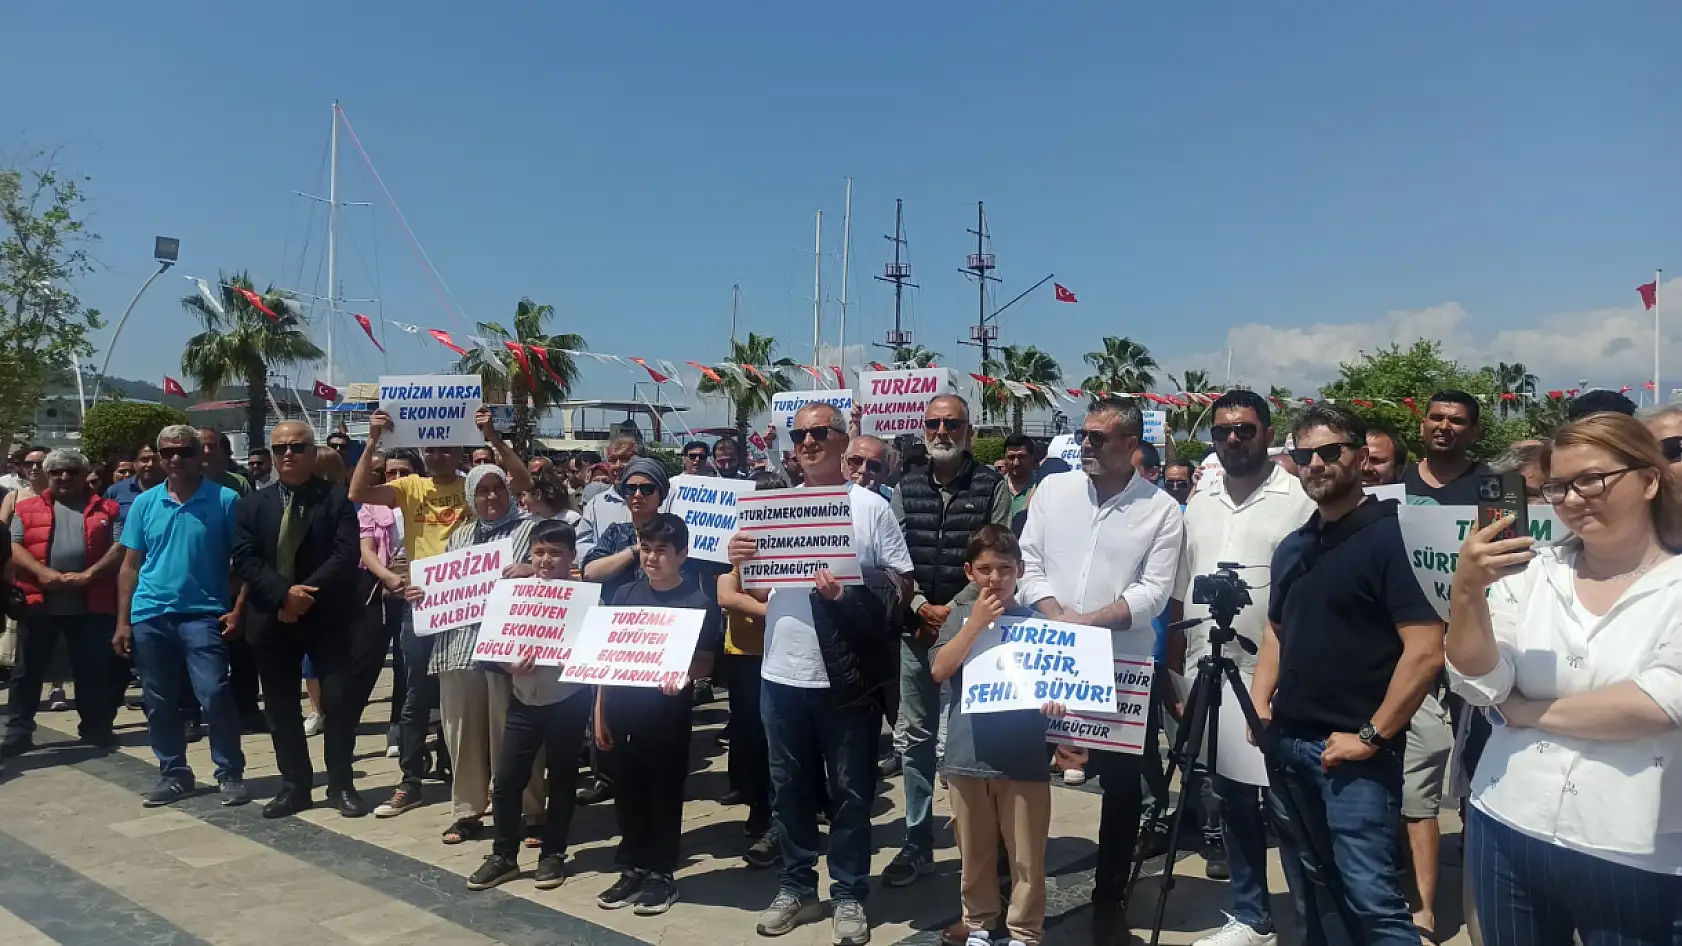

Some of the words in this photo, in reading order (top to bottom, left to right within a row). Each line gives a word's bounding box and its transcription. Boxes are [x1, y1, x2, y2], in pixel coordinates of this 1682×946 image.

[381, 382, 434, 400] TURİZM
[437, 385, 481, 400] VARSA
[871, 373, 937, 395] TURİZM
[399, 402, 467, 421] EKONOMİ
[774, 396, 820, 412] TURİZ
[821, 398, 852, 410] ARSA
[863, 401, 929, 416] KALKINMA
[418, 426, 451, 440] VAR!
[875, 415, 925, 432] KALBİDİ
[677, 484, 718, 505] TURİZM
[739, 501, 850, 521] #TURİZMEKONOMİDİR
[693, 534, 720, 553] VAR!
[424, 550, 500, 586] TURİZM
[512, 581, 574, 600] TURİZMLE
[429, 599, 487, 629] KALBİDİ
[509, 601, 568, 619] BÜYÜYEN
[612, 608, 677, 626] TURİZMLE
[501, 623, 566, 643] EKONOMİ,
[607, 628, 668, 645] BÜYÜYEN
[1001, 623, 1076, 647] TURİZM
[476, 640, 515, 658] GÜÇLÜ
[517, 643, 572, 660] YARINLA
[597, 648, 666, 666] EKONOMİ,
[565, 663, 610, 681] GÜÇLÜ
[611, 668, 686, 686] YARINLAR!
[1034, 677, 1113, 703] BÜYÜR!
